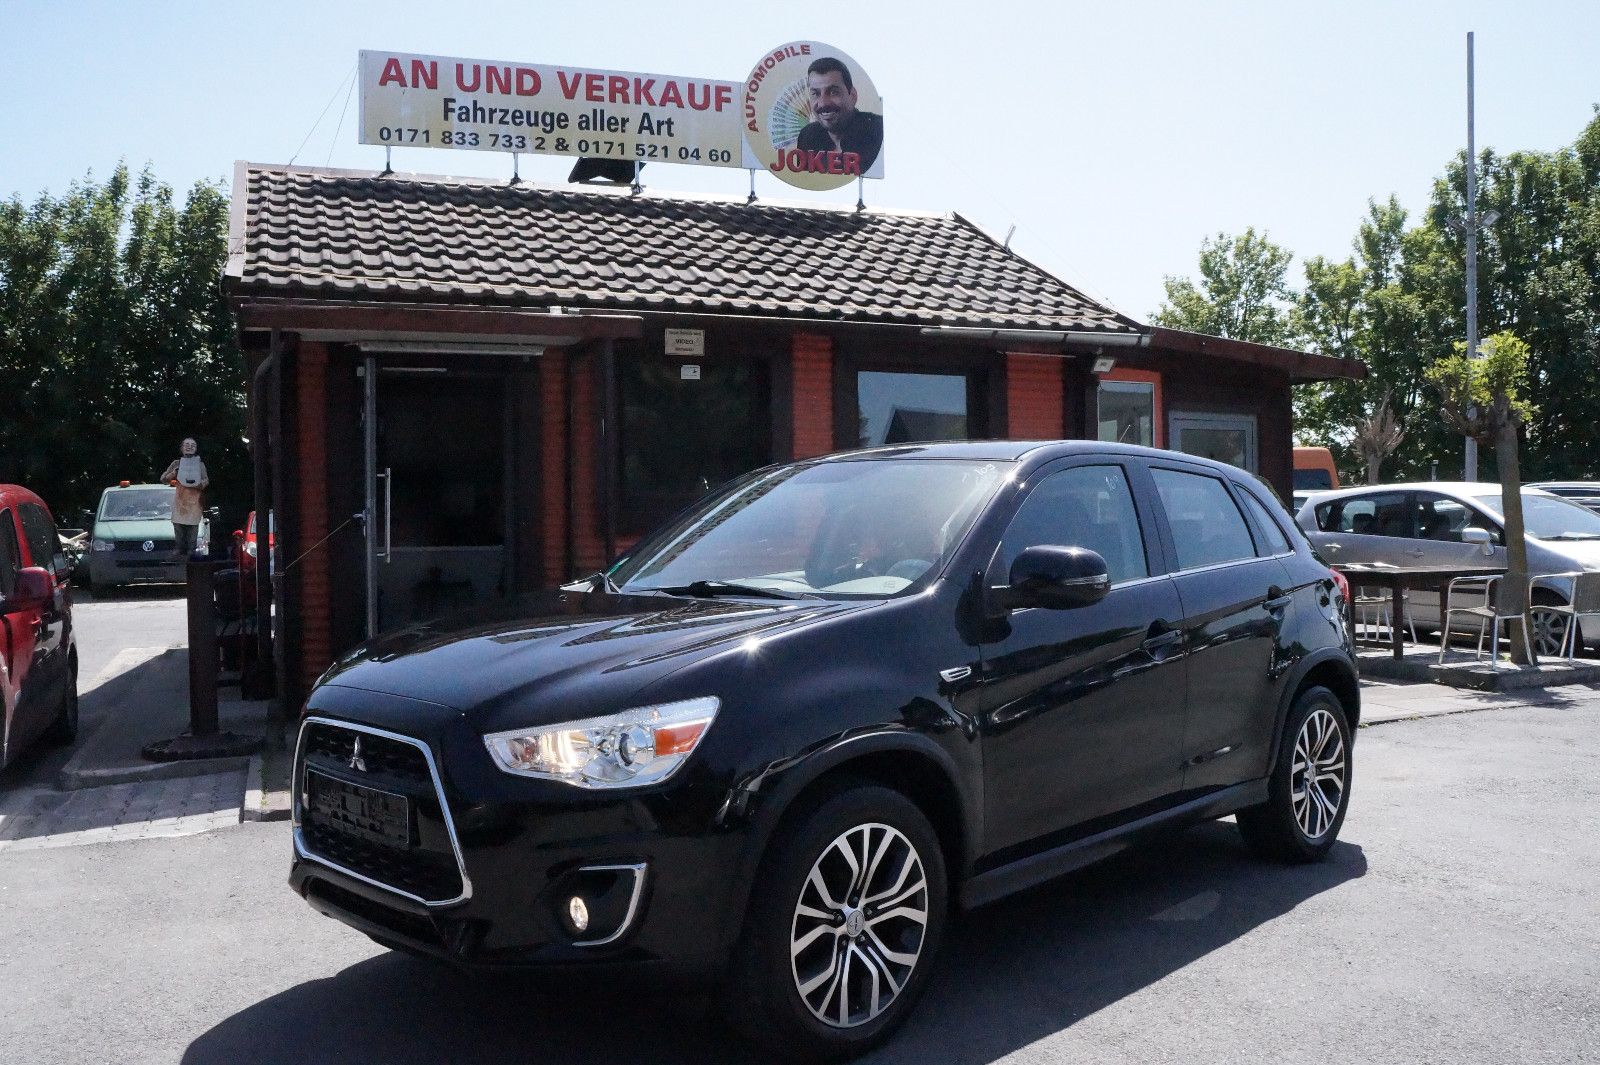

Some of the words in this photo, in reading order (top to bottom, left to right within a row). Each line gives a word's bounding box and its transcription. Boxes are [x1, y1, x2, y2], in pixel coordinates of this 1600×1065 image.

[378, 57, 438, 90] AN
[455, 62, 542, 96] UND
[556, 70, 732, 112] VERKAUF
[745, 44, 811, 133] AUTOMOBILE
[443, 97, 570, 134] Fahrzeuge
[577, 108, 630, 133] aller
[637, 112, 675, 138] Art
[379, 126, 431, 143] 0171
[441, 130, 480, 146] 833
[488, 133, 526, 149] 733
[534, 136, 546, 151] 2
[554, 137, 570, 152] &
[577, 139, 625, 156] 0171
[635, 143, 669, 159] 521
[678, 146, 702, 161] 04
[708, 148, 732, 163] 60
[769, 148, 862, 176] JOKER
